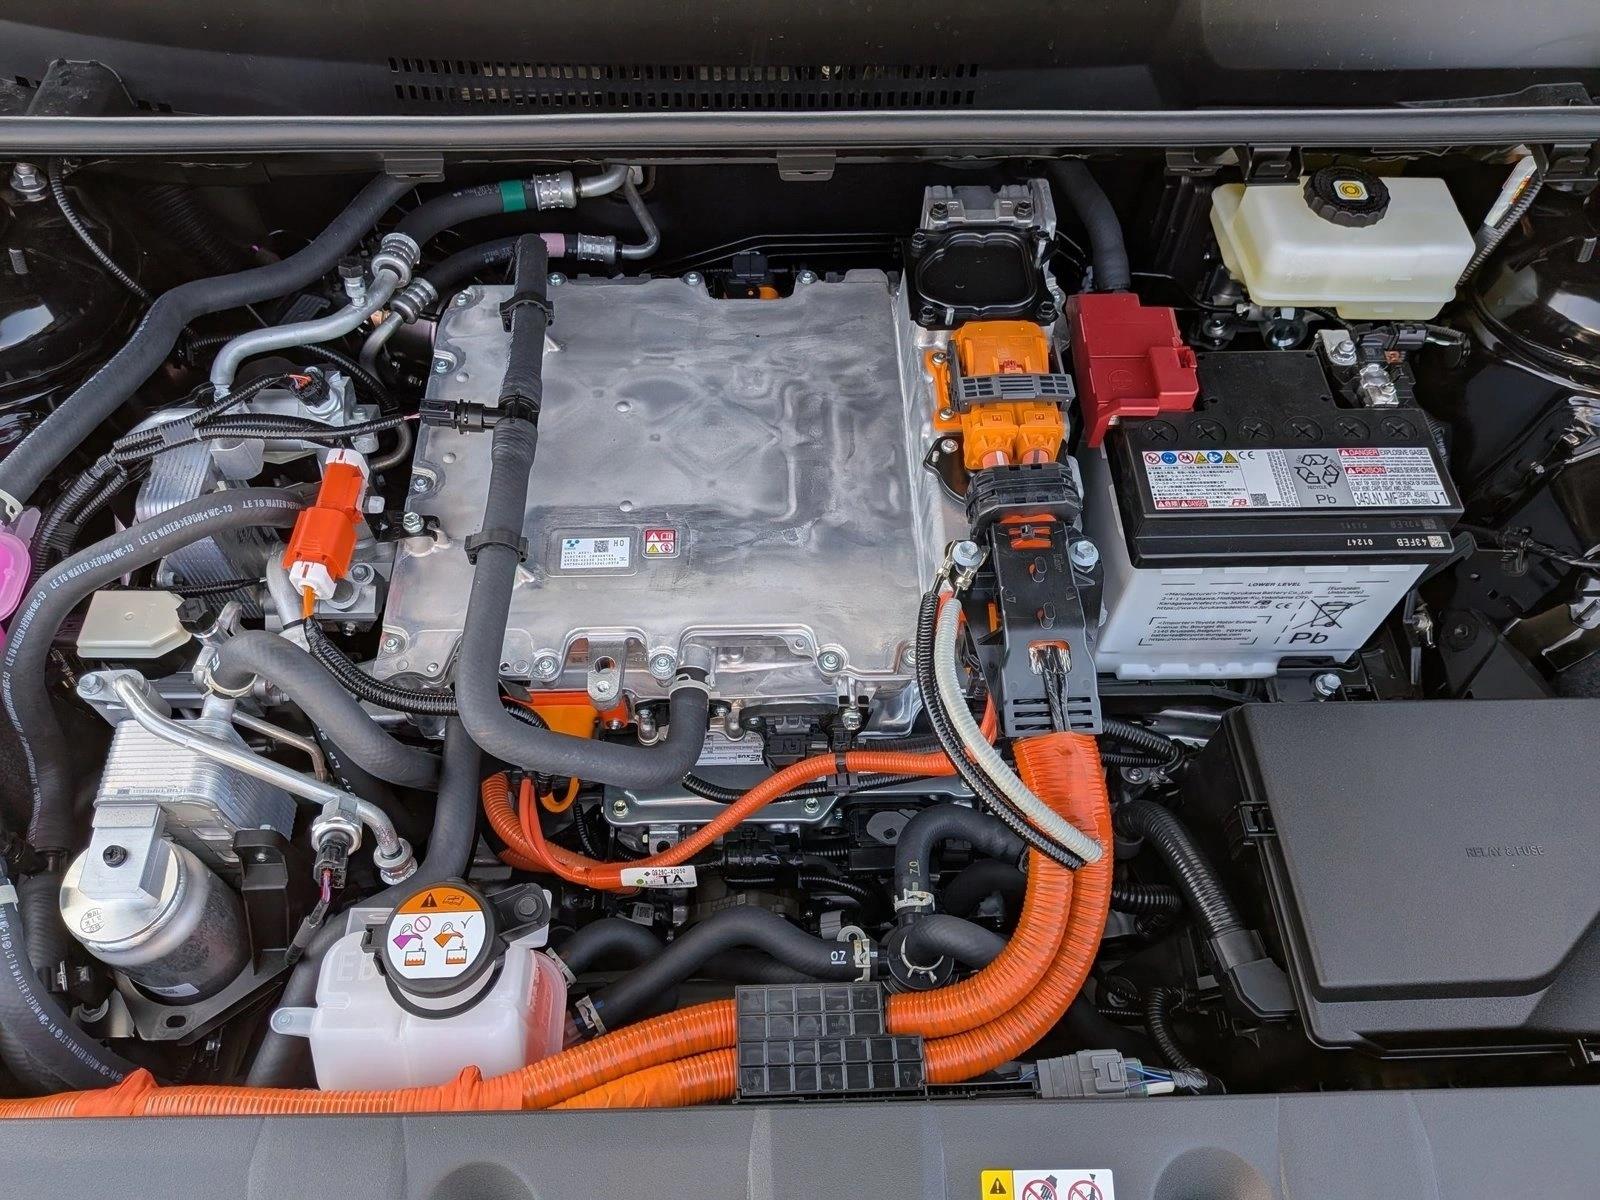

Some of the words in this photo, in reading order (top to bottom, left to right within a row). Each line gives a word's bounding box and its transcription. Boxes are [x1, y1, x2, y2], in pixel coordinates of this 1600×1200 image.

[1316, 494, 1337, 504] Pb
[1288, 632, 1329, 644] Pb
[1465, 846, 1501, 858] RELAY
[1505, 846, 1514, 856] &
[1515, 845, 1545, 856] FUSE
[659, 874, 684, 884] TA
